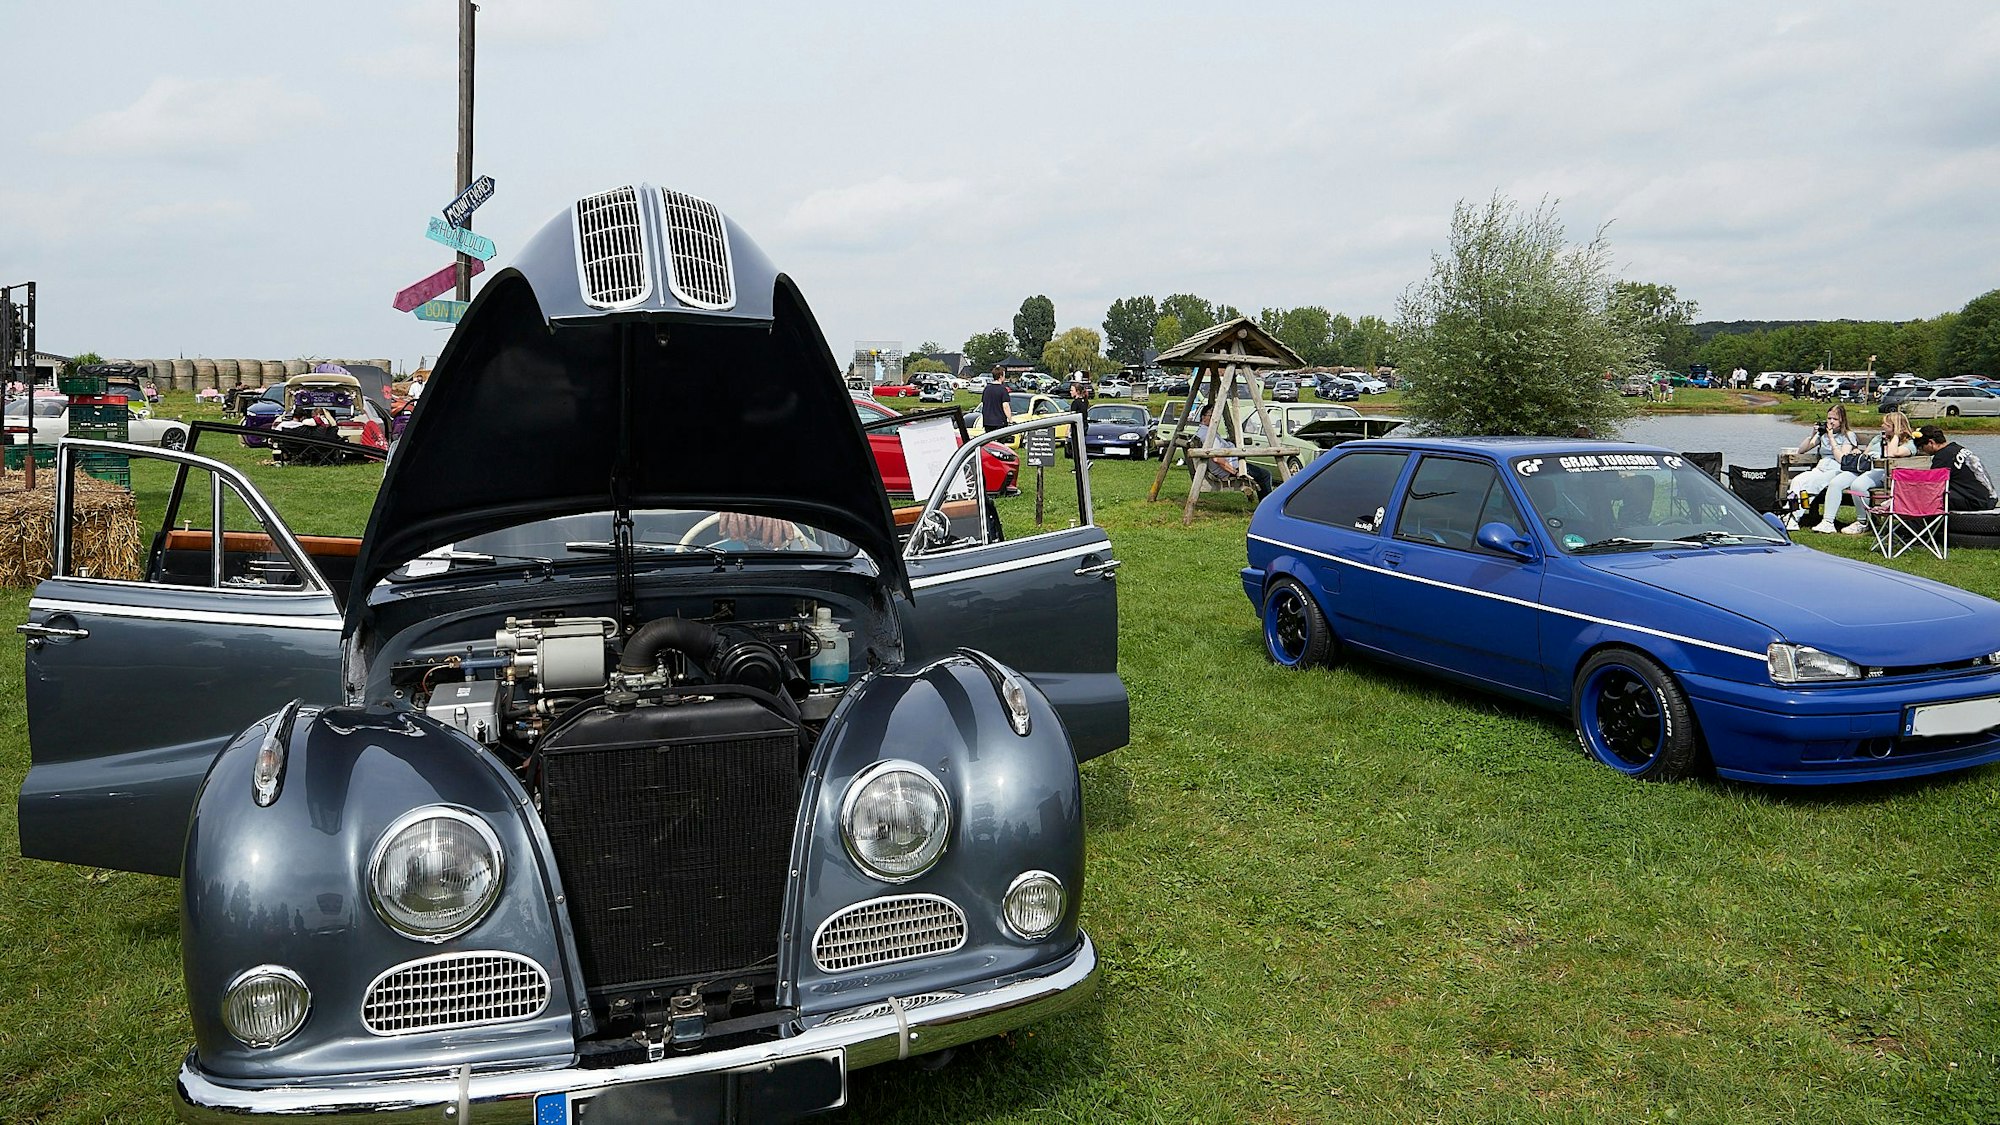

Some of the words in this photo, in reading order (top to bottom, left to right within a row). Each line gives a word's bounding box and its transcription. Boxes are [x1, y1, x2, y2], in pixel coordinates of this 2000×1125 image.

[446, 192, 471, 223] MOUNT
[467, 176, 493, 204] EVEREST
[425, 302, 449, 318] BON
[1559, 455, 1600, 468] GRAN
[1598, 454, 1658, 466] TURISMO
[1656, 686, 1672, 737] FALKEN
